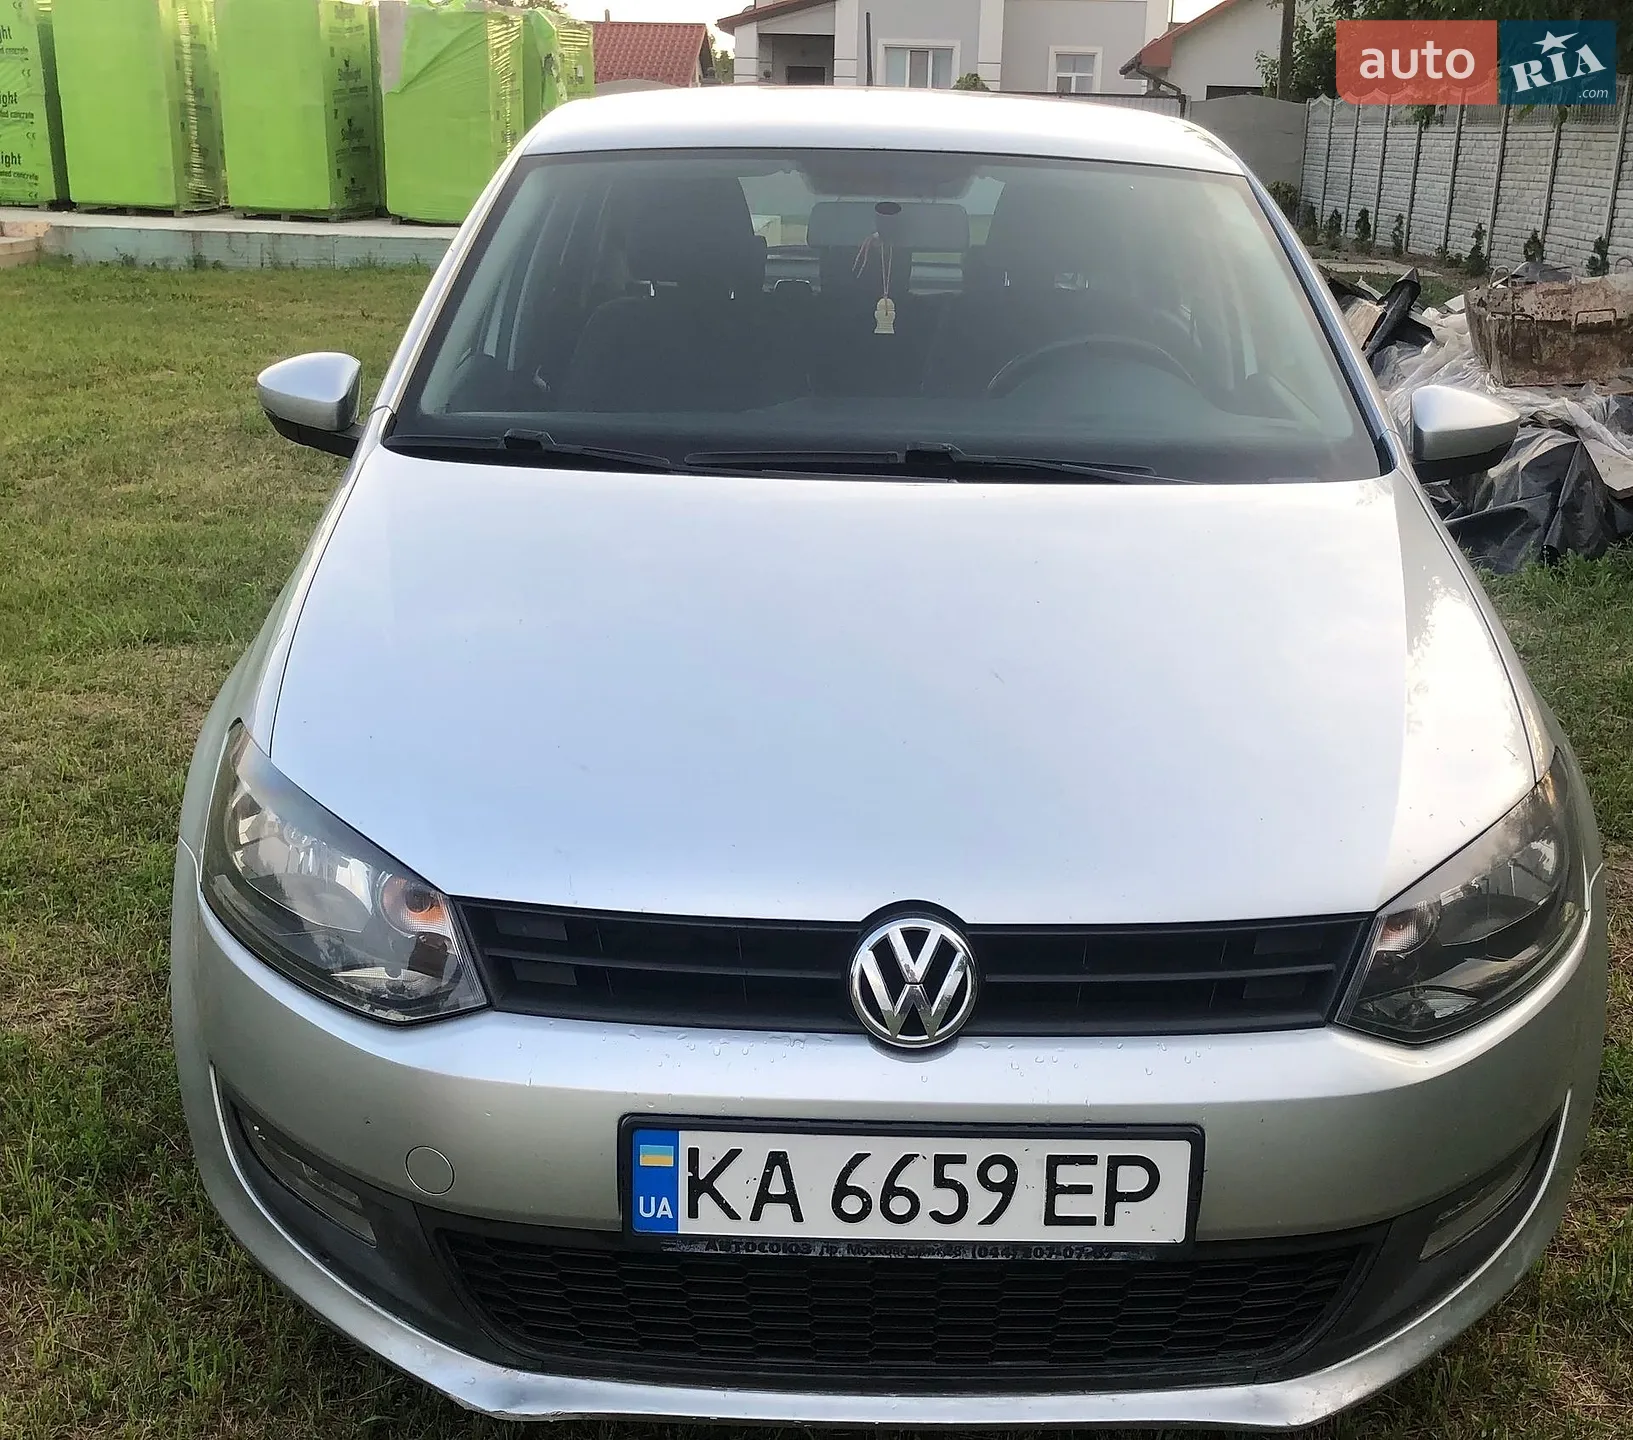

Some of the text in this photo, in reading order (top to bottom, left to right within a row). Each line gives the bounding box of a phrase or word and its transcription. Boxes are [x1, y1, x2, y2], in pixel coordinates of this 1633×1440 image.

[639, 1196, 673, 1219] UA
[687, 1147, 1160, 1226] KA 6659 EP
